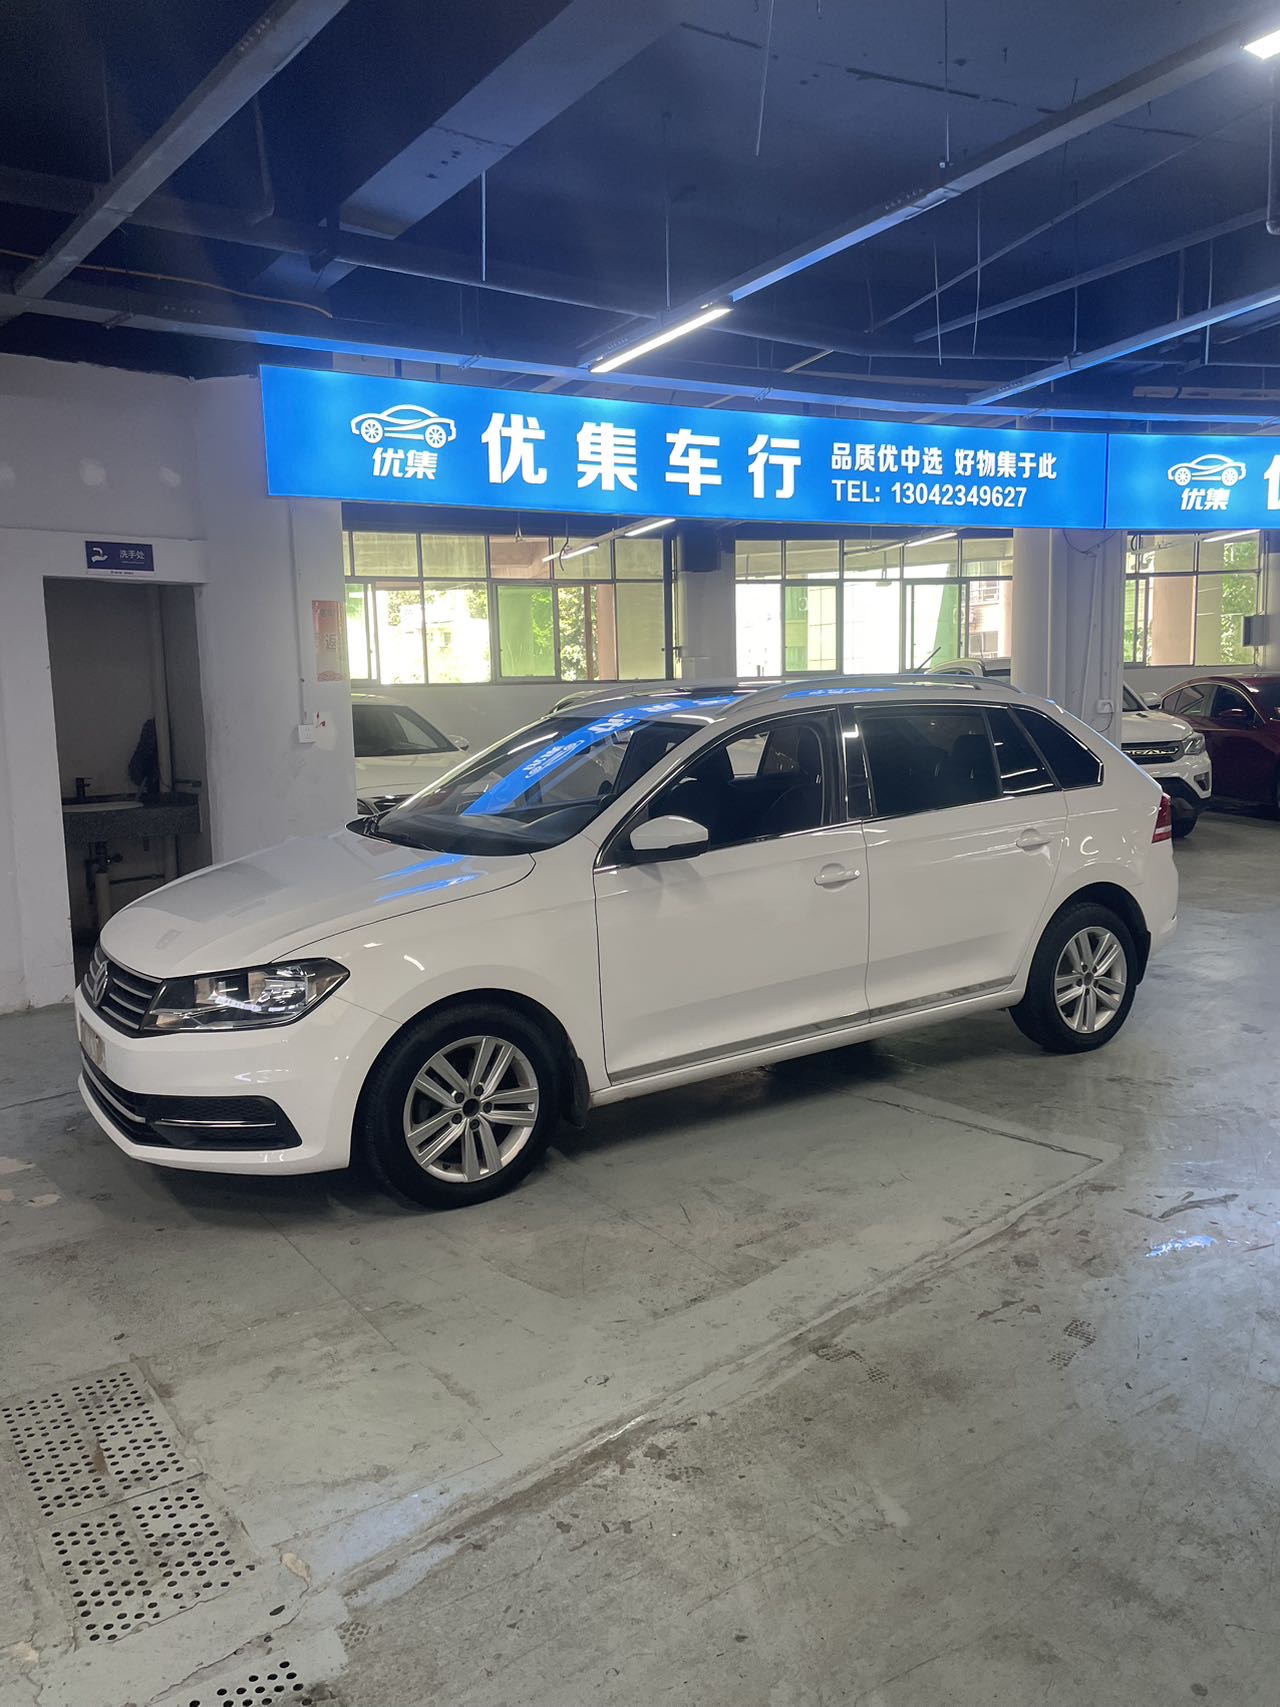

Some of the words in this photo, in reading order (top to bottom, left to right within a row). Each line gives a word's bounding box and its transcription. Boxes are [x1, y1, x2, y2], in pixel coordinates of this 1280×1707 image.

[372, 447, 438, 480] 优集
[481, 412, 802, 499] 优集车行
[831, 442, 943, 475] 品质优中选
[954, 448, 1057, 479] 好物集于此
[832, 479, 881, 503] TEL:
[891, 482, 1027, 507] 13042349627
[1180, 487, 1231, 511] 优集
[119, 549, 145, 560] 洗手处
